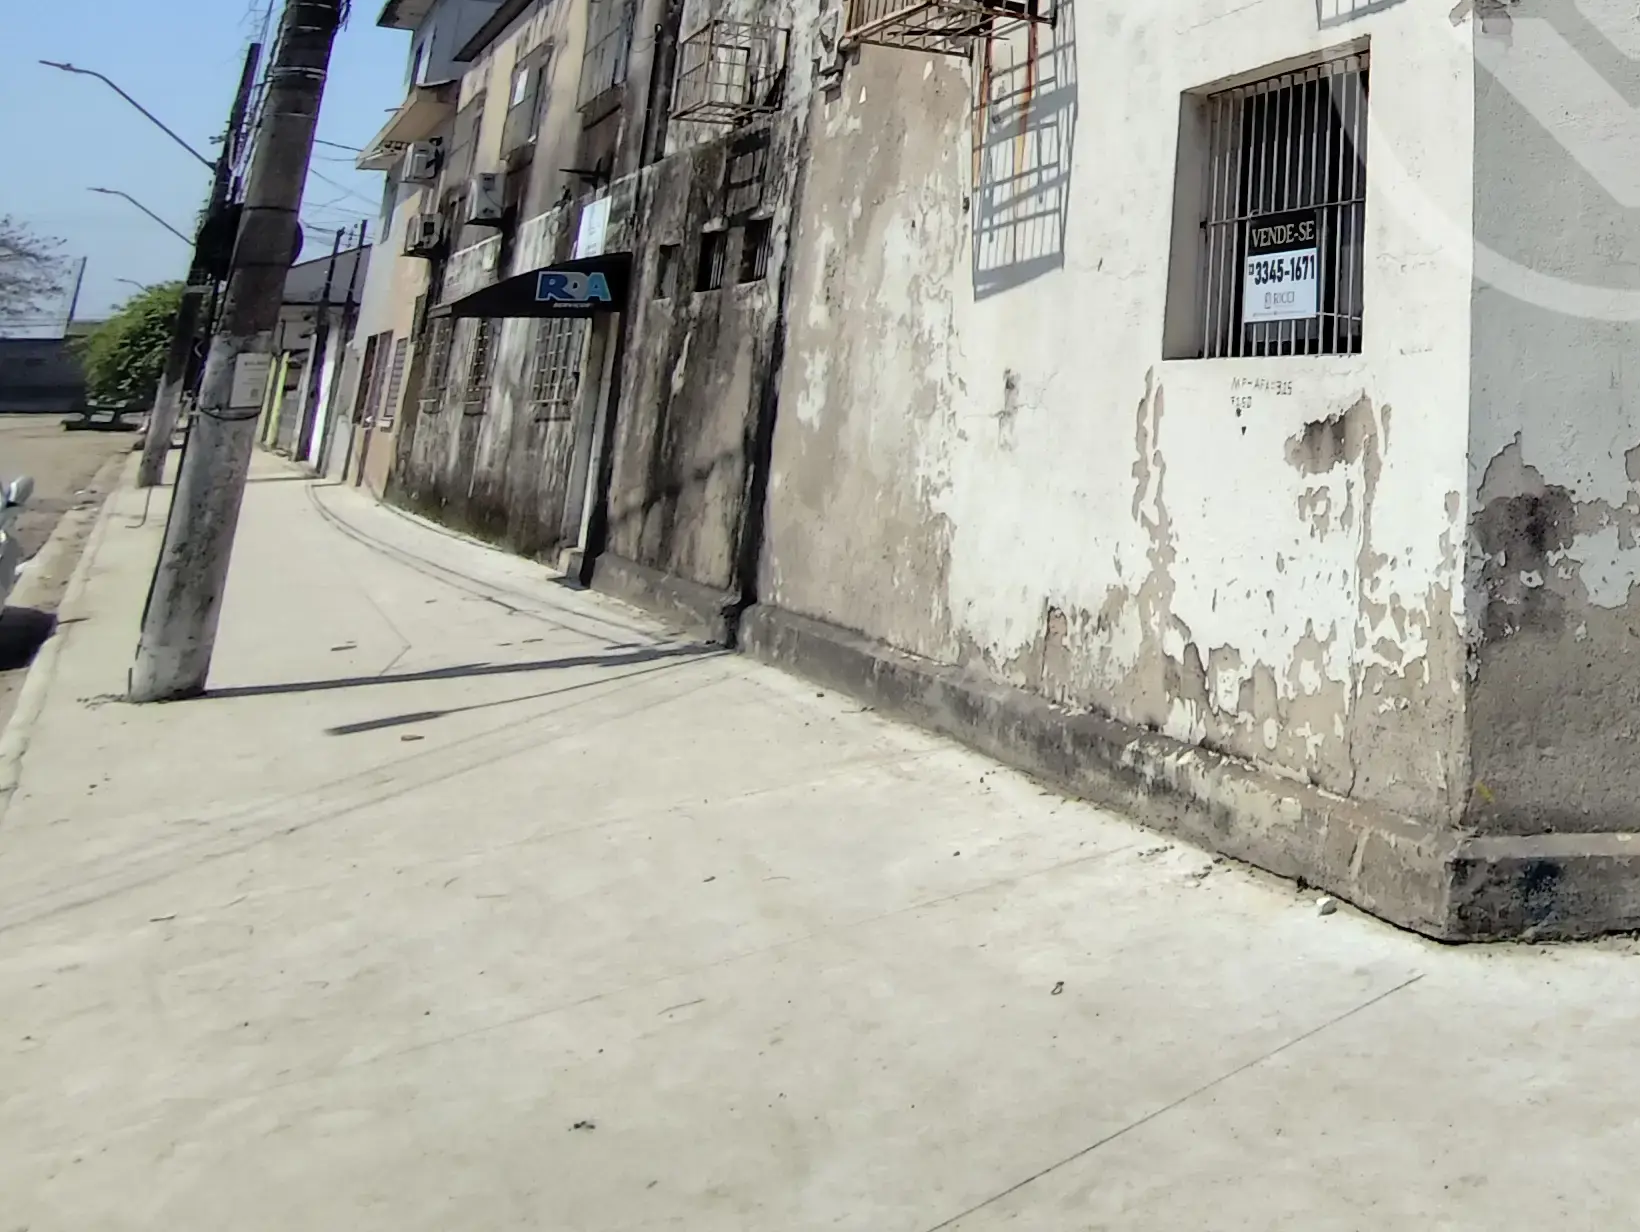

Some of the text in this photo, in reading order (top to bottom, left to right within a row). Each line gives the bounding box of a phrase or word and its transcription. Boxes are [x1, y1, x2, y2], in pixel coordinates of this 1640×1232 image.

[1252, 220, 1315, 248] VENDE-SE
[1254, 254, 1315, 286] 3345-1671
[535, 271, 612, 301] RDA
